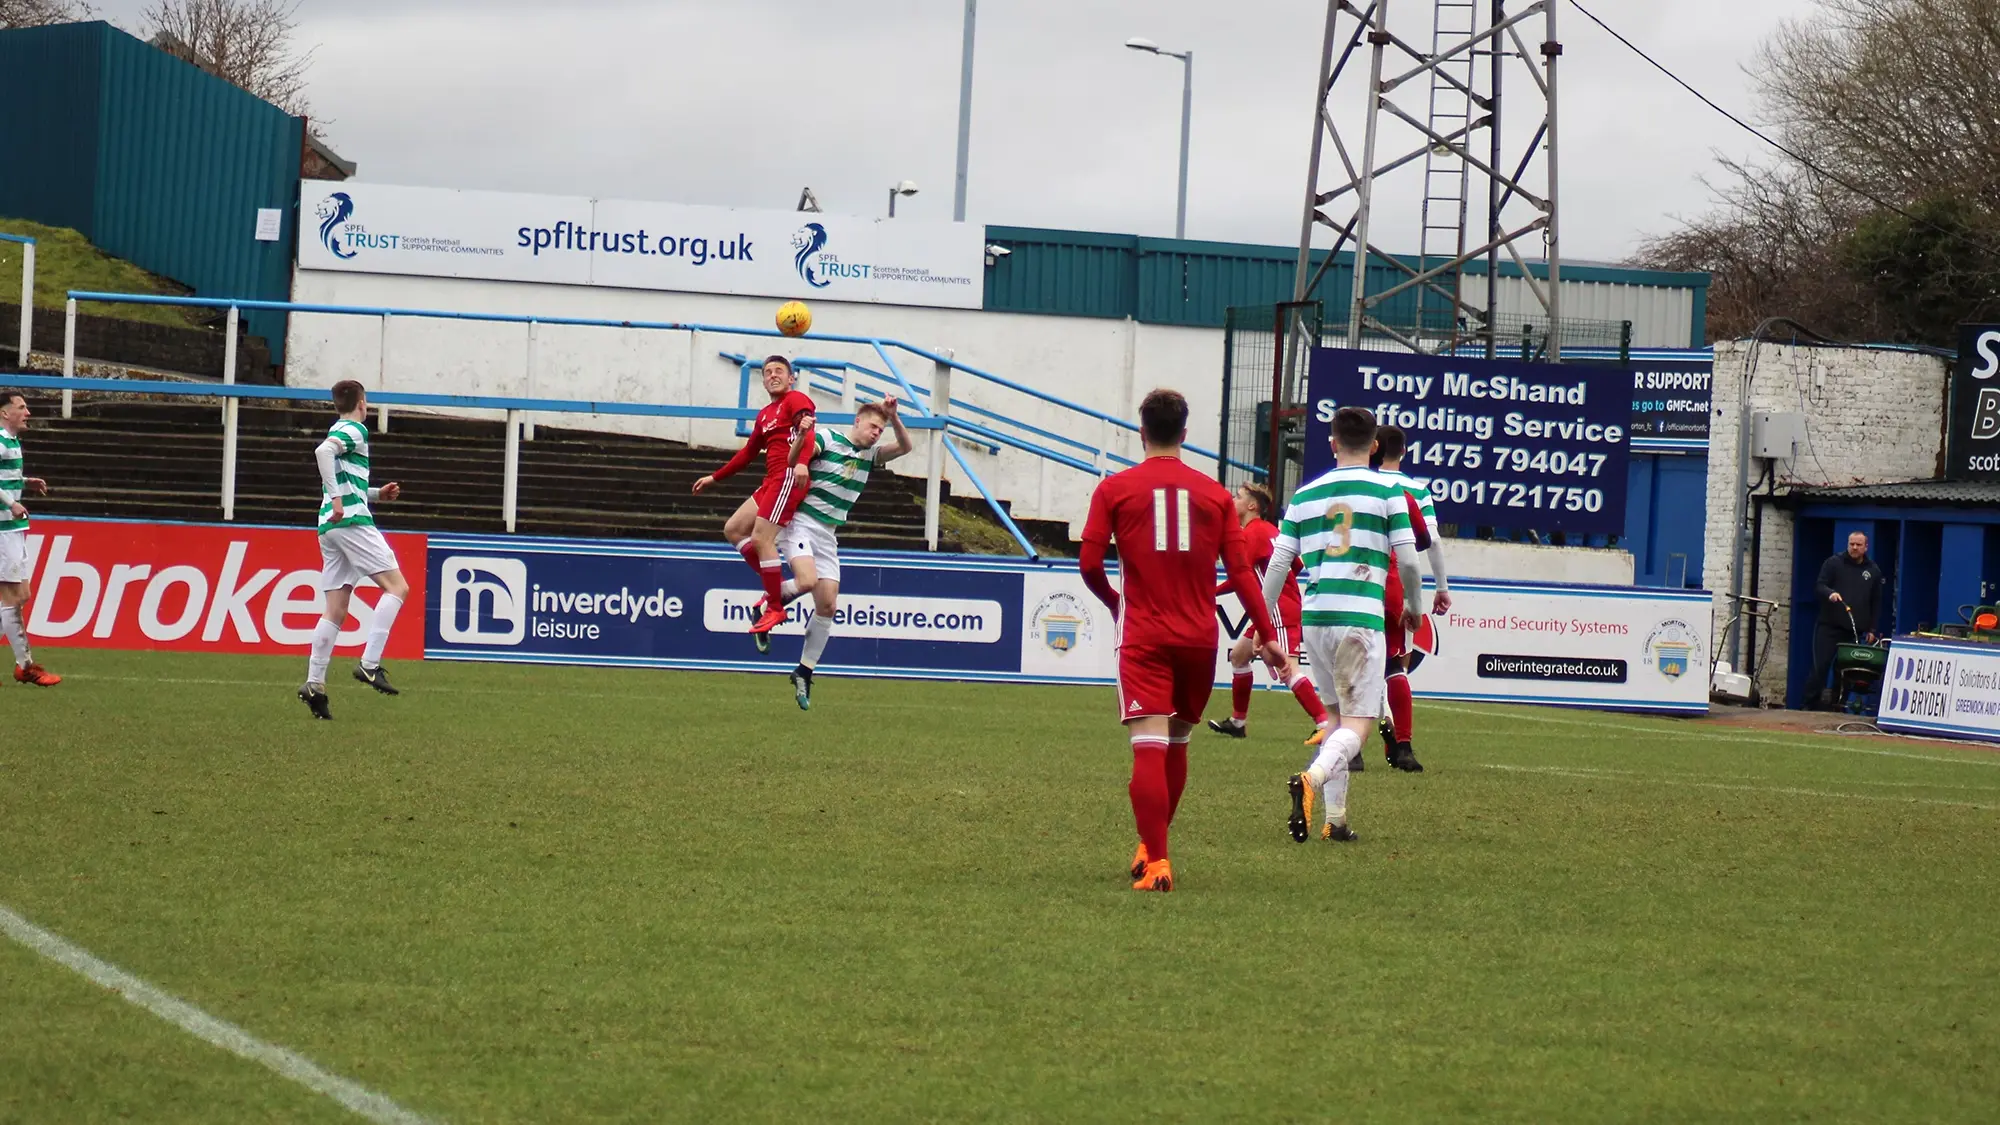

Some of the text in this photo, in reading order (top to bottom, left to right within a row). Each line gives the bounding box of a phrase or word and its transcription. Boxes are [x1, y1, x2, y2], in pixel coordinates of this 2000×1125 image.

[344, 224, 366, 233] SPFL
[344, 233, 400, 249] TRUST
[402, 236, 460, 246] Scottish Football
[402, 243, 504, 256] SUPPORTING COMMUNITIES
[517, 220, 754, 266] spfltrust.org.uk
[819, 254, 839, 263] SPFL
[819, 262, 871, 279] TRUST
[873, 265, 929, 275] Scottish Football
[873, 272, 971, 285] SUPPORTING COMMUNITIES
[1971, 331, 2000, 379] S
[1358, 366, 1587, 405] Tony McShand
[1647, 372, 1711, 390] SUPPORT
[1642, 401, 1653, 413] go
[1655, 400, 1665, 411] to
[1666, 400, 1709, 412] GMFC.net
[1315, 399, 1624, 443] Sffolding Service
[1400, 441, 1607, 477] 1475 794047
[1153, 488, 1191, 551] 11
[1325, 503, 1354, 558] 3
[532, 584, 683, 623] inverclyde
[1049, 593, 1075, 601] MORTON
[722, 598, 983, 631] invclyeleisure.com
[1449, 613, 1629, 635] Fire and Security Systems
[1661, 620, 1687, 629] MORTON
[532, 616, 600, 640] leisure
[1485, 658, 1618, 677] oliverintegrated.co.uk
[1915, 658, 1952, 686] BLAIR &
[1959, 668, 1990, 690] Solicitors
[1991, 672, 1997, 690] &
[1910, 690, 1948, 718] BRYDEN
[1955, 698, 1985, 714] GREENOCK
[1985, 701, 1997, 716] AND
